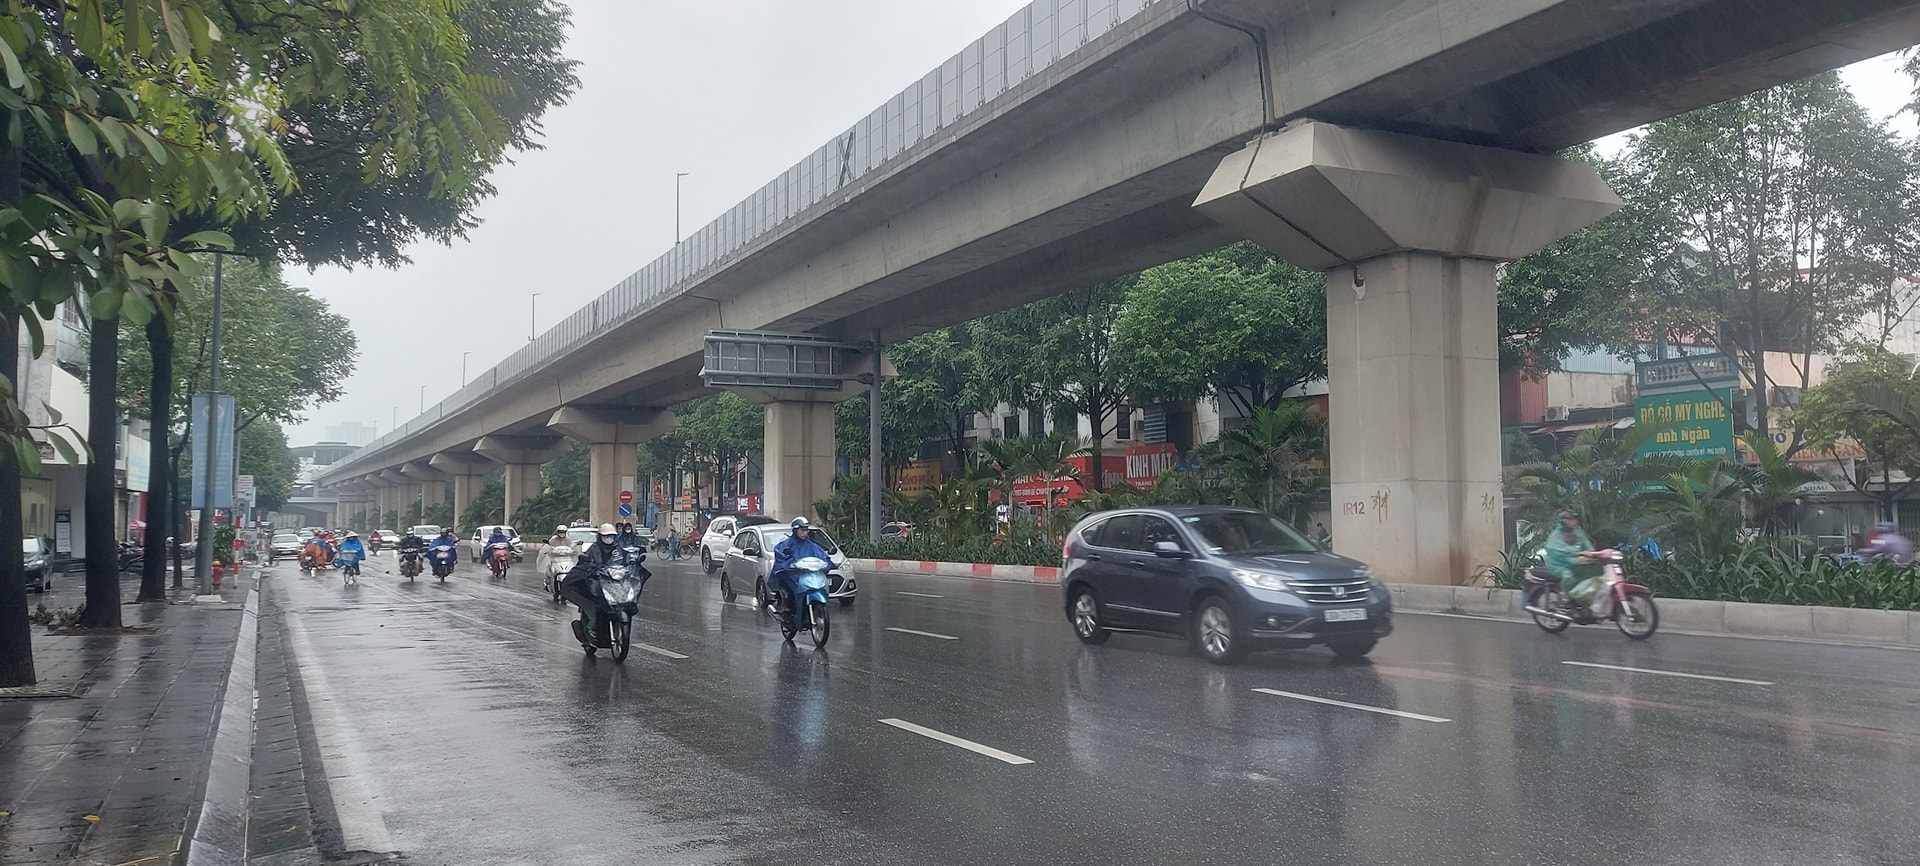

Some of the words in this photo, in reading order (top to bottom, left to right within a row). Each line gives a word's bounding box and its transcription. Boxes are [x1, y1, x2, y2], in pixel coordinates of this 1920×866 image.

[1675, 400, 1692, 421] MỸ
[1656, 430, 1678, 443] Anh
[1681, 426, 1711, 444] Ngân
[1126, 450, 1149, 479] KÍNH
